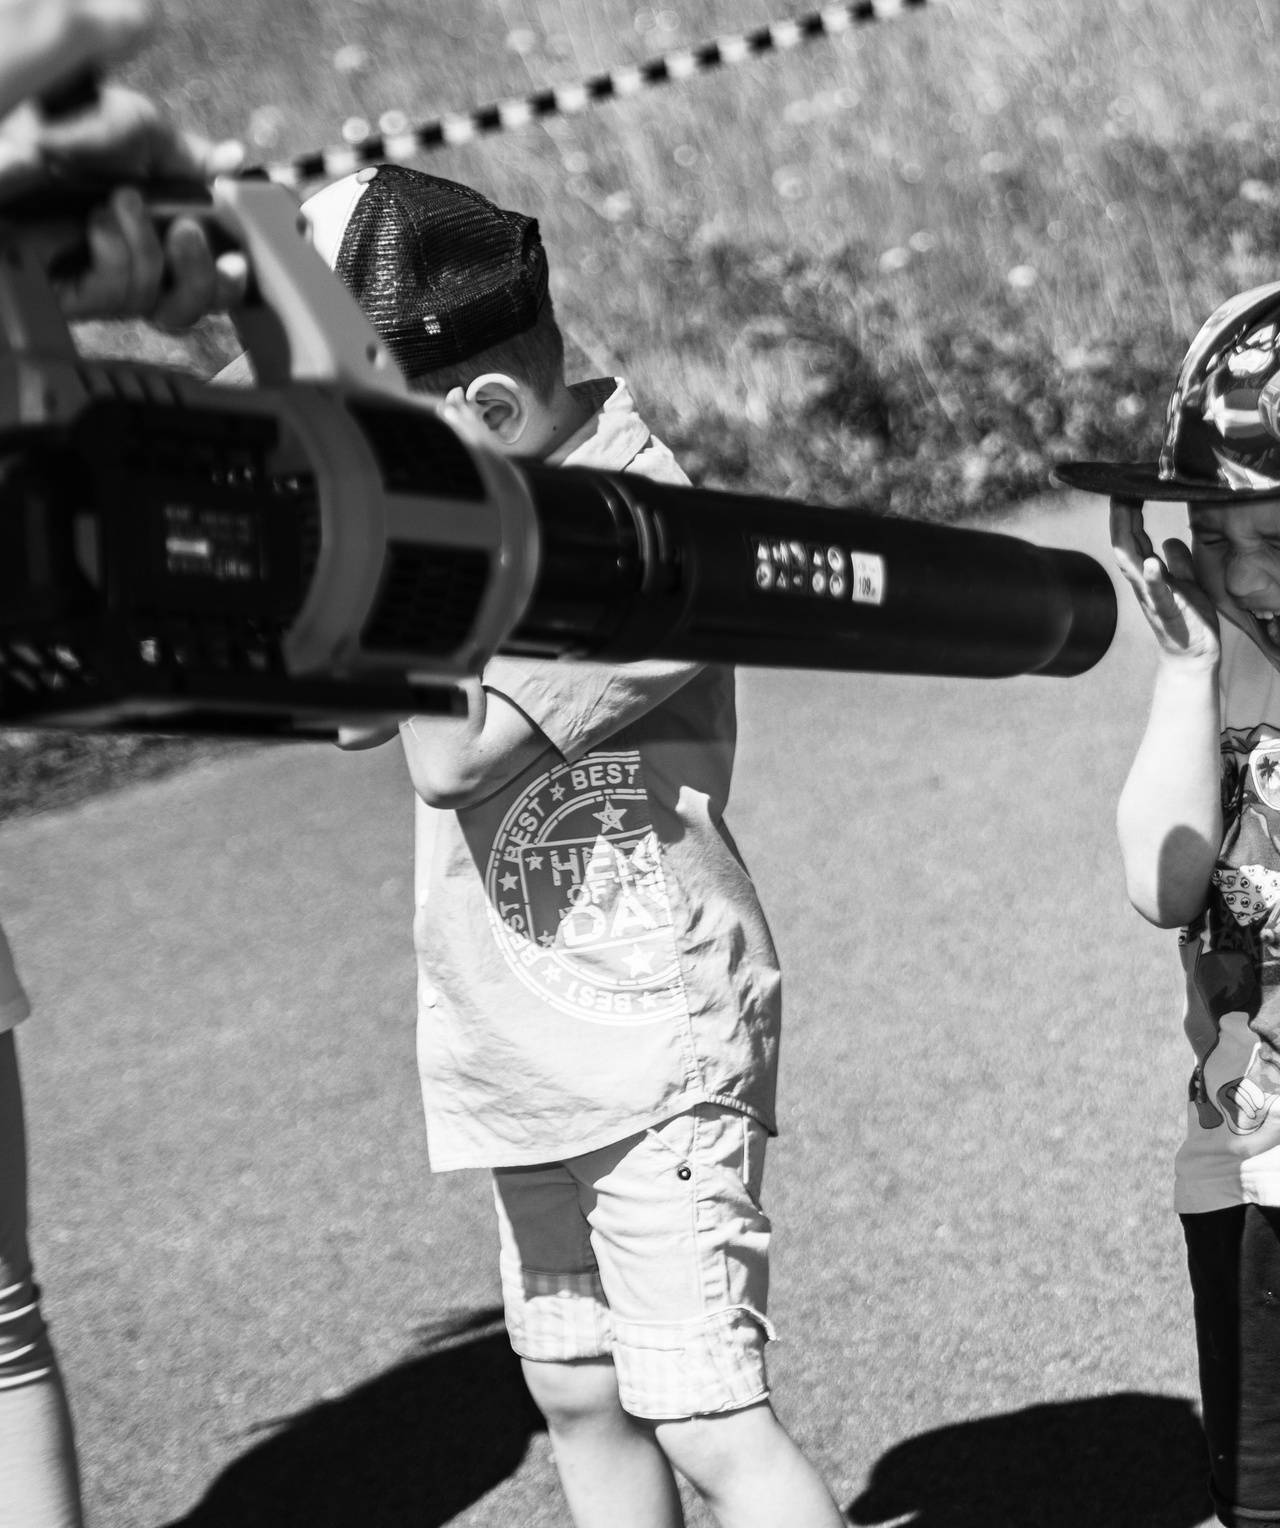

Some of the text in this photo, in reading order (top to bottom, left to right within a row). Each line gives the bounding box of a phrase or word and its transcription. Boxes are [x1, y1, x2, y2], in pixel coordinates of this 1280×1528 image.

[571, 763, 640, 790] BEST
[503, 798, 546, 863] BEST
[563, 980, 633, 1014] BEST
